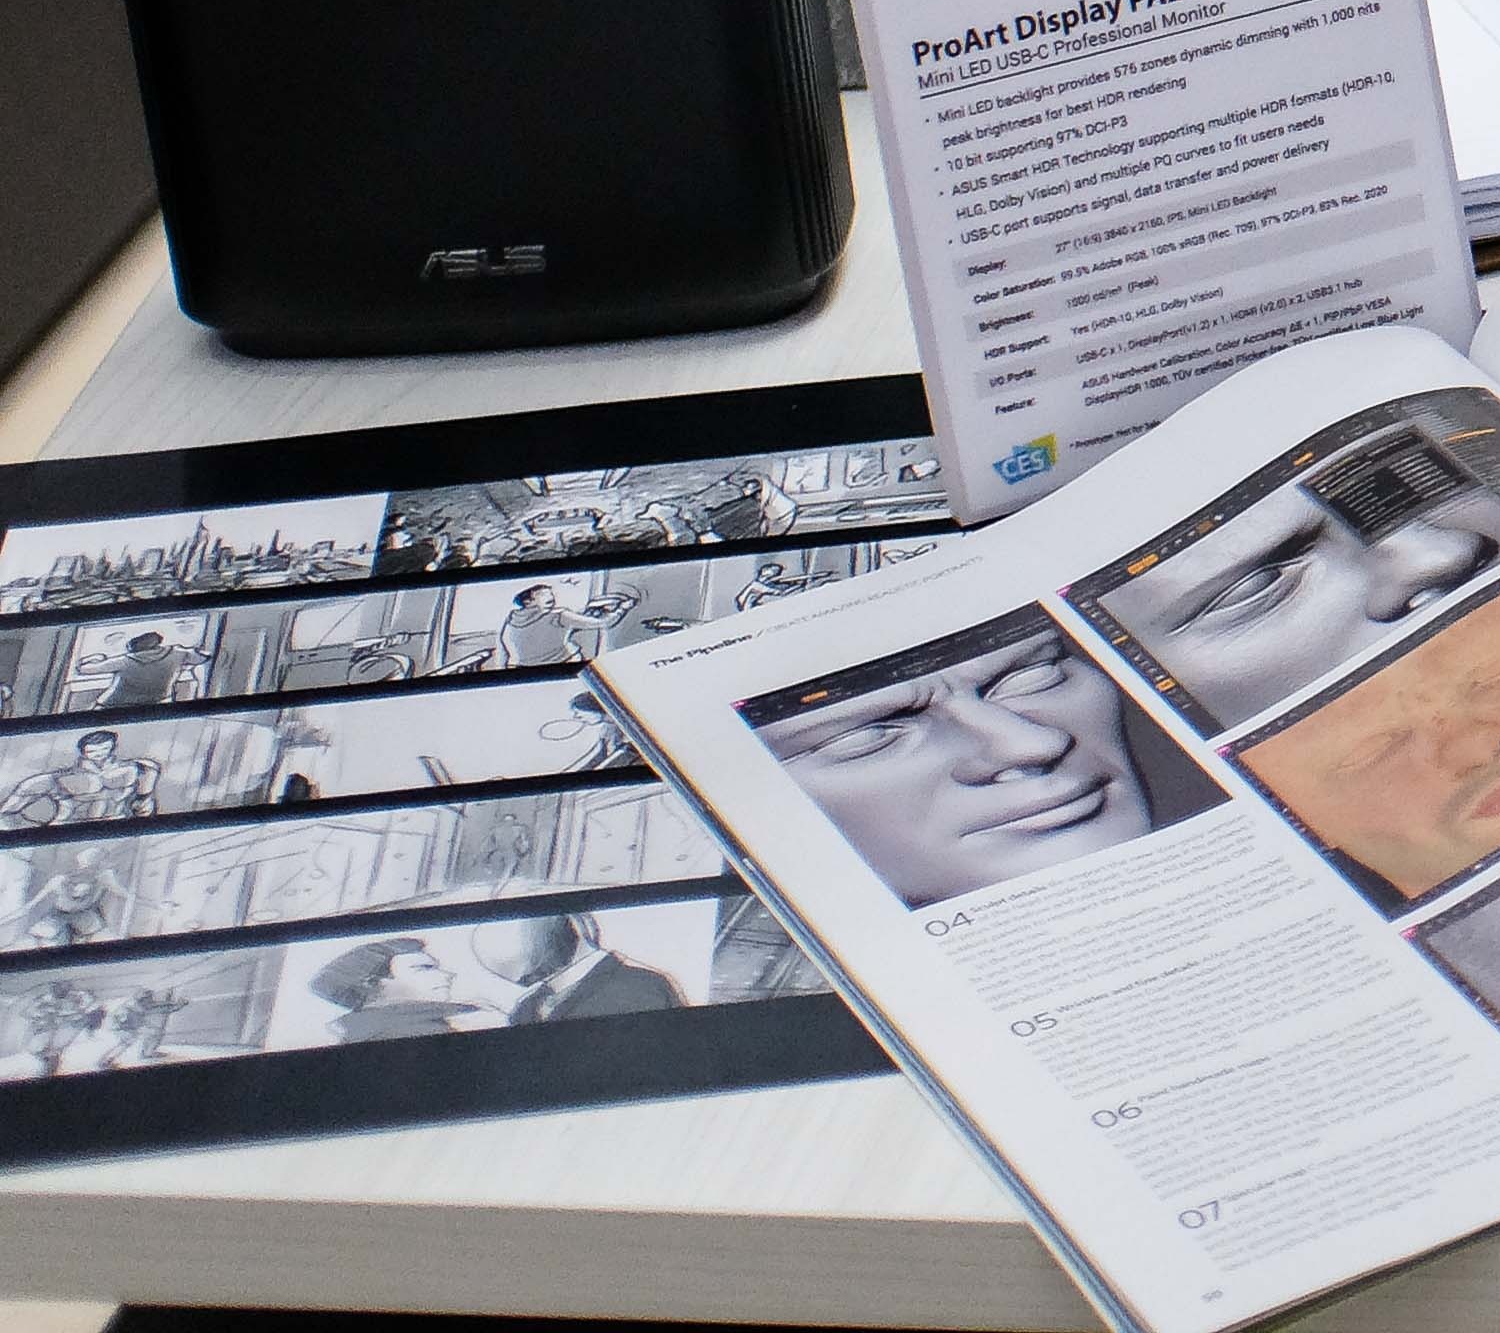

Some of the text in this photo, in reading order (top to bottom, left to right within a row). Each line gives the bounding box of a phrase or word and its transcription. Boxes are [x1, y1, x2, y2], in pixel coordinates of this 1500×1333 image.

[911, 23, 1009, 66] ProArt
[917, 1, 1225, 89] Mini LED USB-C Professional Monitor
[937, 105, 965, 123] Mini
[967, 99, 993, 115] LED
[995, 84, 1054, 108] backlight
[1057, 71, 1110, 95] provides
[1140, 54, 1177, 72] zones
[1179, 39, 1233, 62] dynamic
[1235, 25, 1289, 47] dimming
[1291, 15, 1319, 32] with
[1321, 6, 1354, 24] 1,000
[942, 76, 1186, 149] peak brightness for best HDR rendering
[951, 71, 1395, 196] ASUS Smart HDR Technology supporting multiple HDR formats (HDR-10,
[946, 114, 1128, 171] 10 bit supporting 97% DCI-P3
[955, 114, 1324, 219] HLG, Dolby Vision) and multiple PQ curves to fit users needs
[960, 139, 1329, 244] USB-C port supports signal, data transfer and power delivery
[420, 245, 546, 278] ASUS
[1002, 450, 1046, 478] CES
[925, 911, 976, 937] 04
[1010, 1011, 1058, 1037] 05
[1092, 1101, 1142, 1128] 06
[1179, 1200, 1219, 1229] 07
